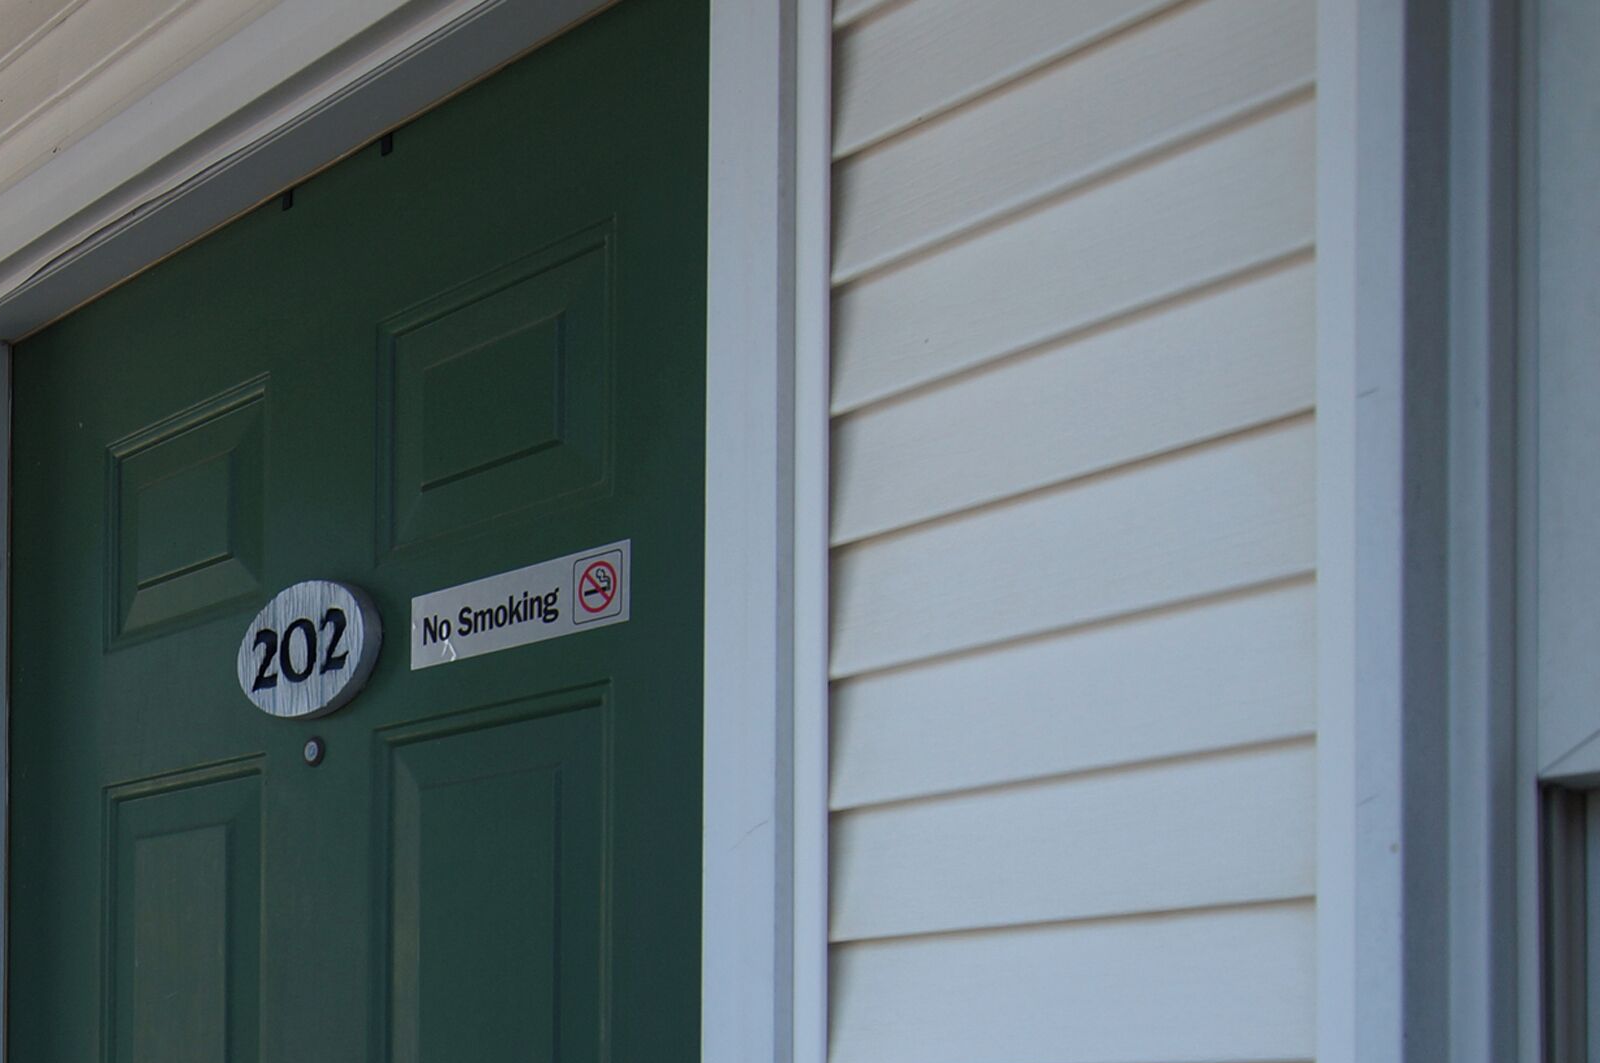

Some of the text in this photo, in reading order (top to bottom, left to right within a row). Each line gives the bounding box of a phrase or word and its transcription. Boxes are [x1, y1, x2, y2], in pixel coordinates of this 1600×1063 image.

[252, 608, 349, 692] 202
[423, 588, 560, 645] No Smoking
